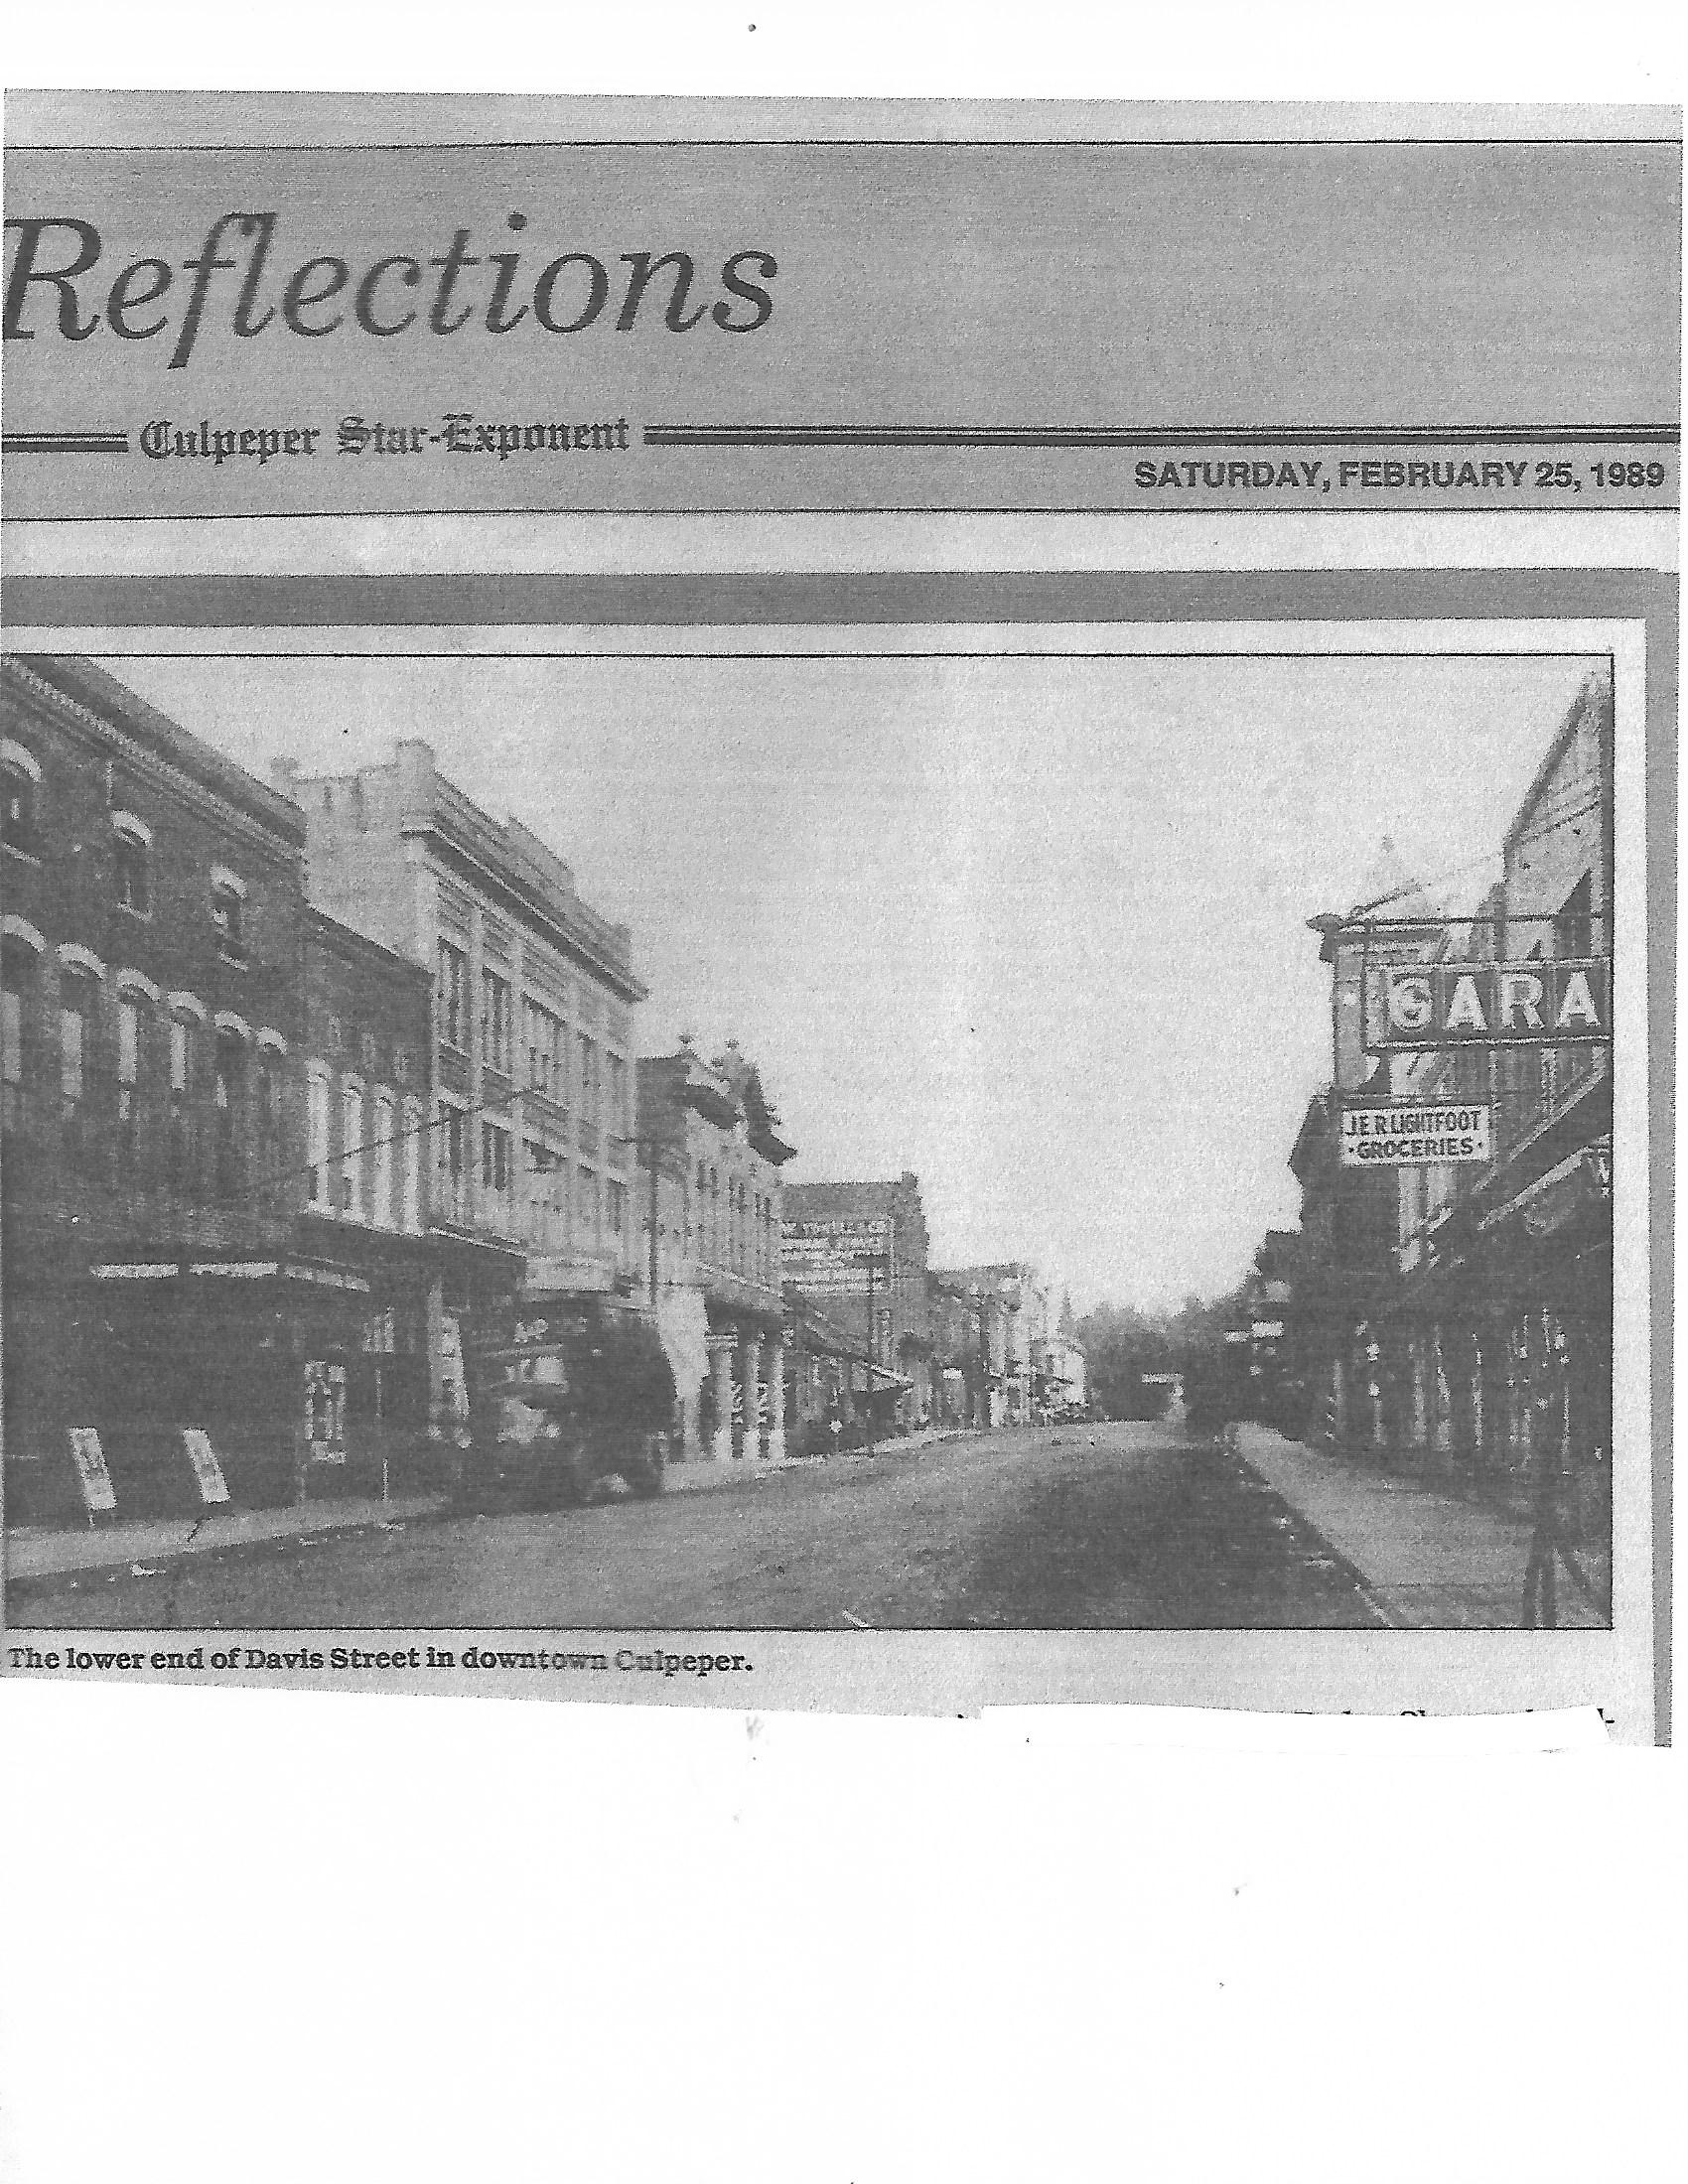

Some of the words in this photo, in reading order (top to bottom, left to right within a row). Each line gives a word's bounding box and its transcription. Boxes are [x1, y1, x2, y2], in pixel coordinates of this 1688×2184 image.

[2, 211, 777, 370] Reflections
[139, 419, 321, 467] Culpeper
[337, 413, 631, 462] Star-Exponent
[1134, 461, 1331, 493] SATURDAY,
[1338, 461, 1528, 488] FEBRUARY
[1535, 462, 1582, 492] 25,
[1591, 462, 1666, 488] 1989
[1390, 970, 1602, 1032] GARA
[8, 1647, 60, 1669] The
[67, 1647, 146, 1669] lower
[151, 1647, 205, 1669] end
[211, 1647, 241, 1669] of
[245, 1647, 325, 1669] Davis
[330, 1647, 420, 1669] Street
[426, 1647, 456, 1668] in
[462, 1647, 609, 1671] downtown
[615, 1649, 754, 1677] Culpeper.
